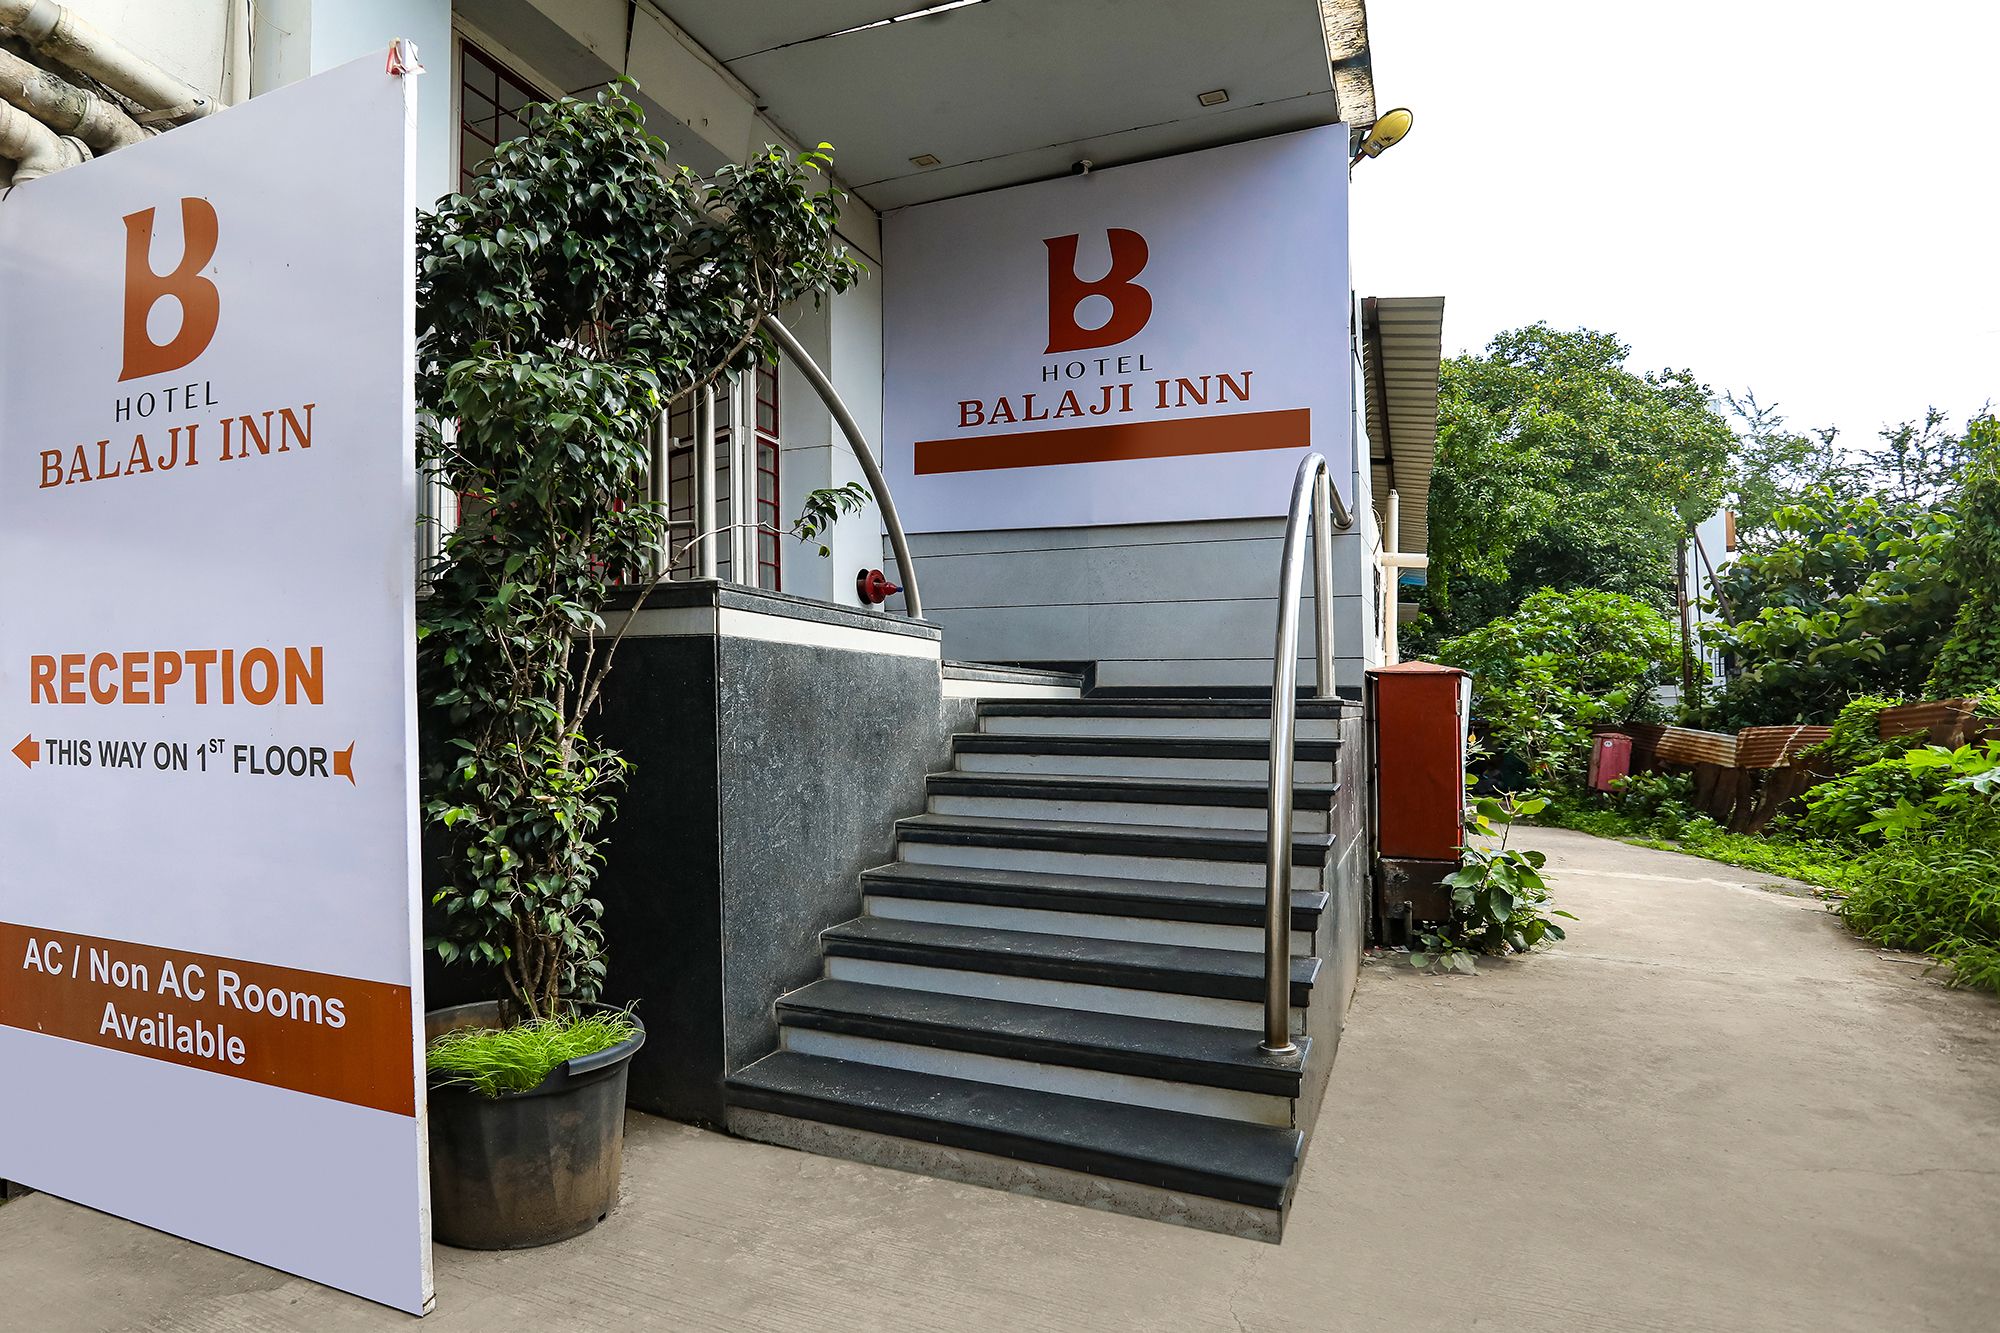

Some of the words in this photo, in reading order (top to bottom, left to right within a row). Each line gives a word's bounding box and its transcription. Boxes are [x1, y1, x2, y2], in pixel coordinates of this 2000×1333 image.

[1041, 353, 1154, 382] HOTEL
[114, 380, 219, 424] HOTEL
[958, 383, 1134, 428] BALAJI
[1155, 370, 1254, 409] INN
[38, 424, 199, 489] BALAJI
[218, 403, 317, 461] INN
[30, 646, 324, 706] RECEPTION
[45, 737, 92, 769] THIS
[98, 740, 147, 770] WAY
[152, 740, 188, 772] ON
[234, 744, 329, 779] FLOOR
[22, 936, 64, 973] AC
[71, 945, 80, 979] /
[89, 948, 149, 991] Non
[157, 958, 206, 1003] AC
[218, 969, 347, 1029] Rooms
[99, 1001, 246, 1065] Available
